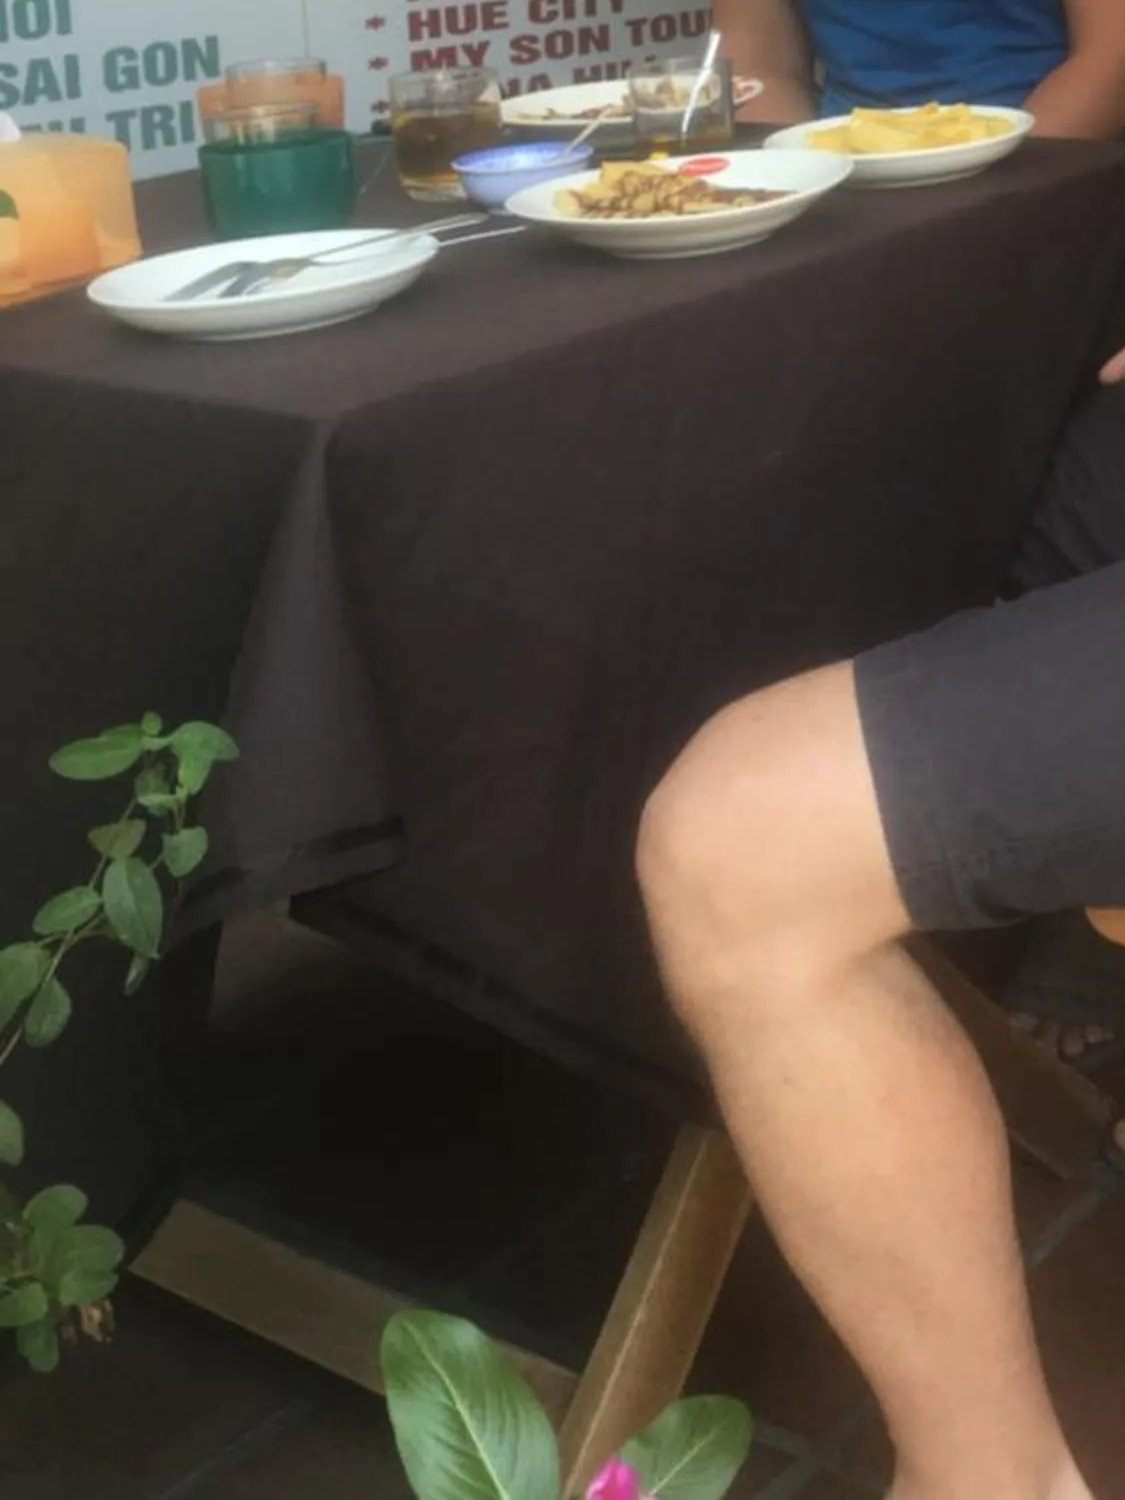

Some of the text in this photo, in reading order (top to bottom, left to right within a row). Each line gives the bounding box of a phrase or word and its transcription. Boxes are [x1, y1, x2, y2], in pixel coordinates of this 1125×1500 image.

[407, 0, 510, 42] HUE
[509, 24, 611, 67] SON
[624, 8, 713, 46] TOU
[103, 35, 222, 93] GON
